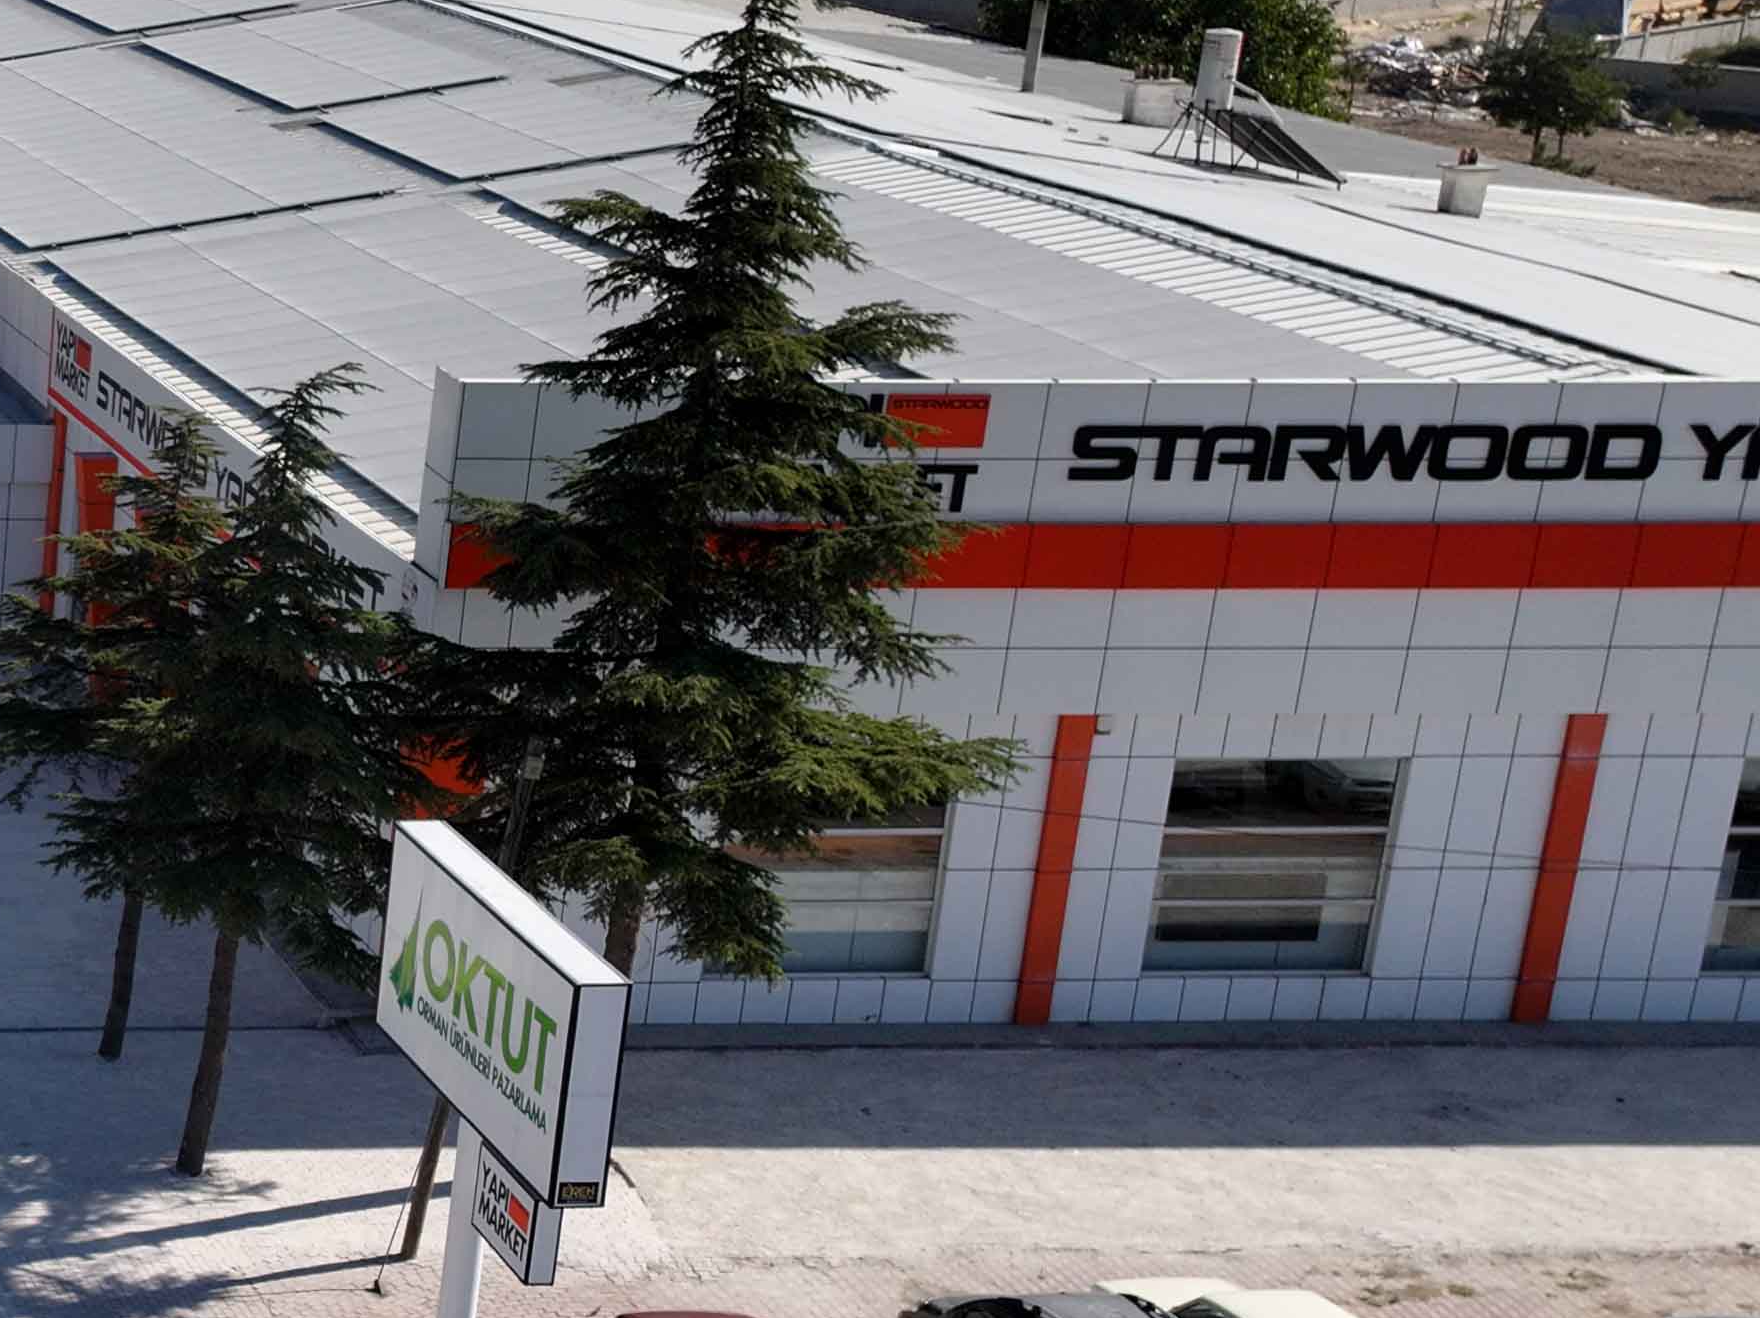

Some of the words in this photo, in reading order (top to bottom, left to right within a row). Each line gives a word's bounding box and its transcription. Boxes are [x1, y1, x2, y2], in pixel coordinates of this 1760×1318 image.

[56, 319, 78, 362] YAPI
[54, 352, 91, 402] MARKET
[1067, 423, 1662, 484] STARWOOD
[422, 919, 557, 1096] OKTUT
[416, 995, 449, 1042] ORMAN
[449, 1023, 491, 1080] ÜRÜNLERİ
[491, 1066, 547, 1135] PAZARLAMA
[482, 1160, 510, 1213] YAPI
[478, 1190, 527, 1262] MARKET
